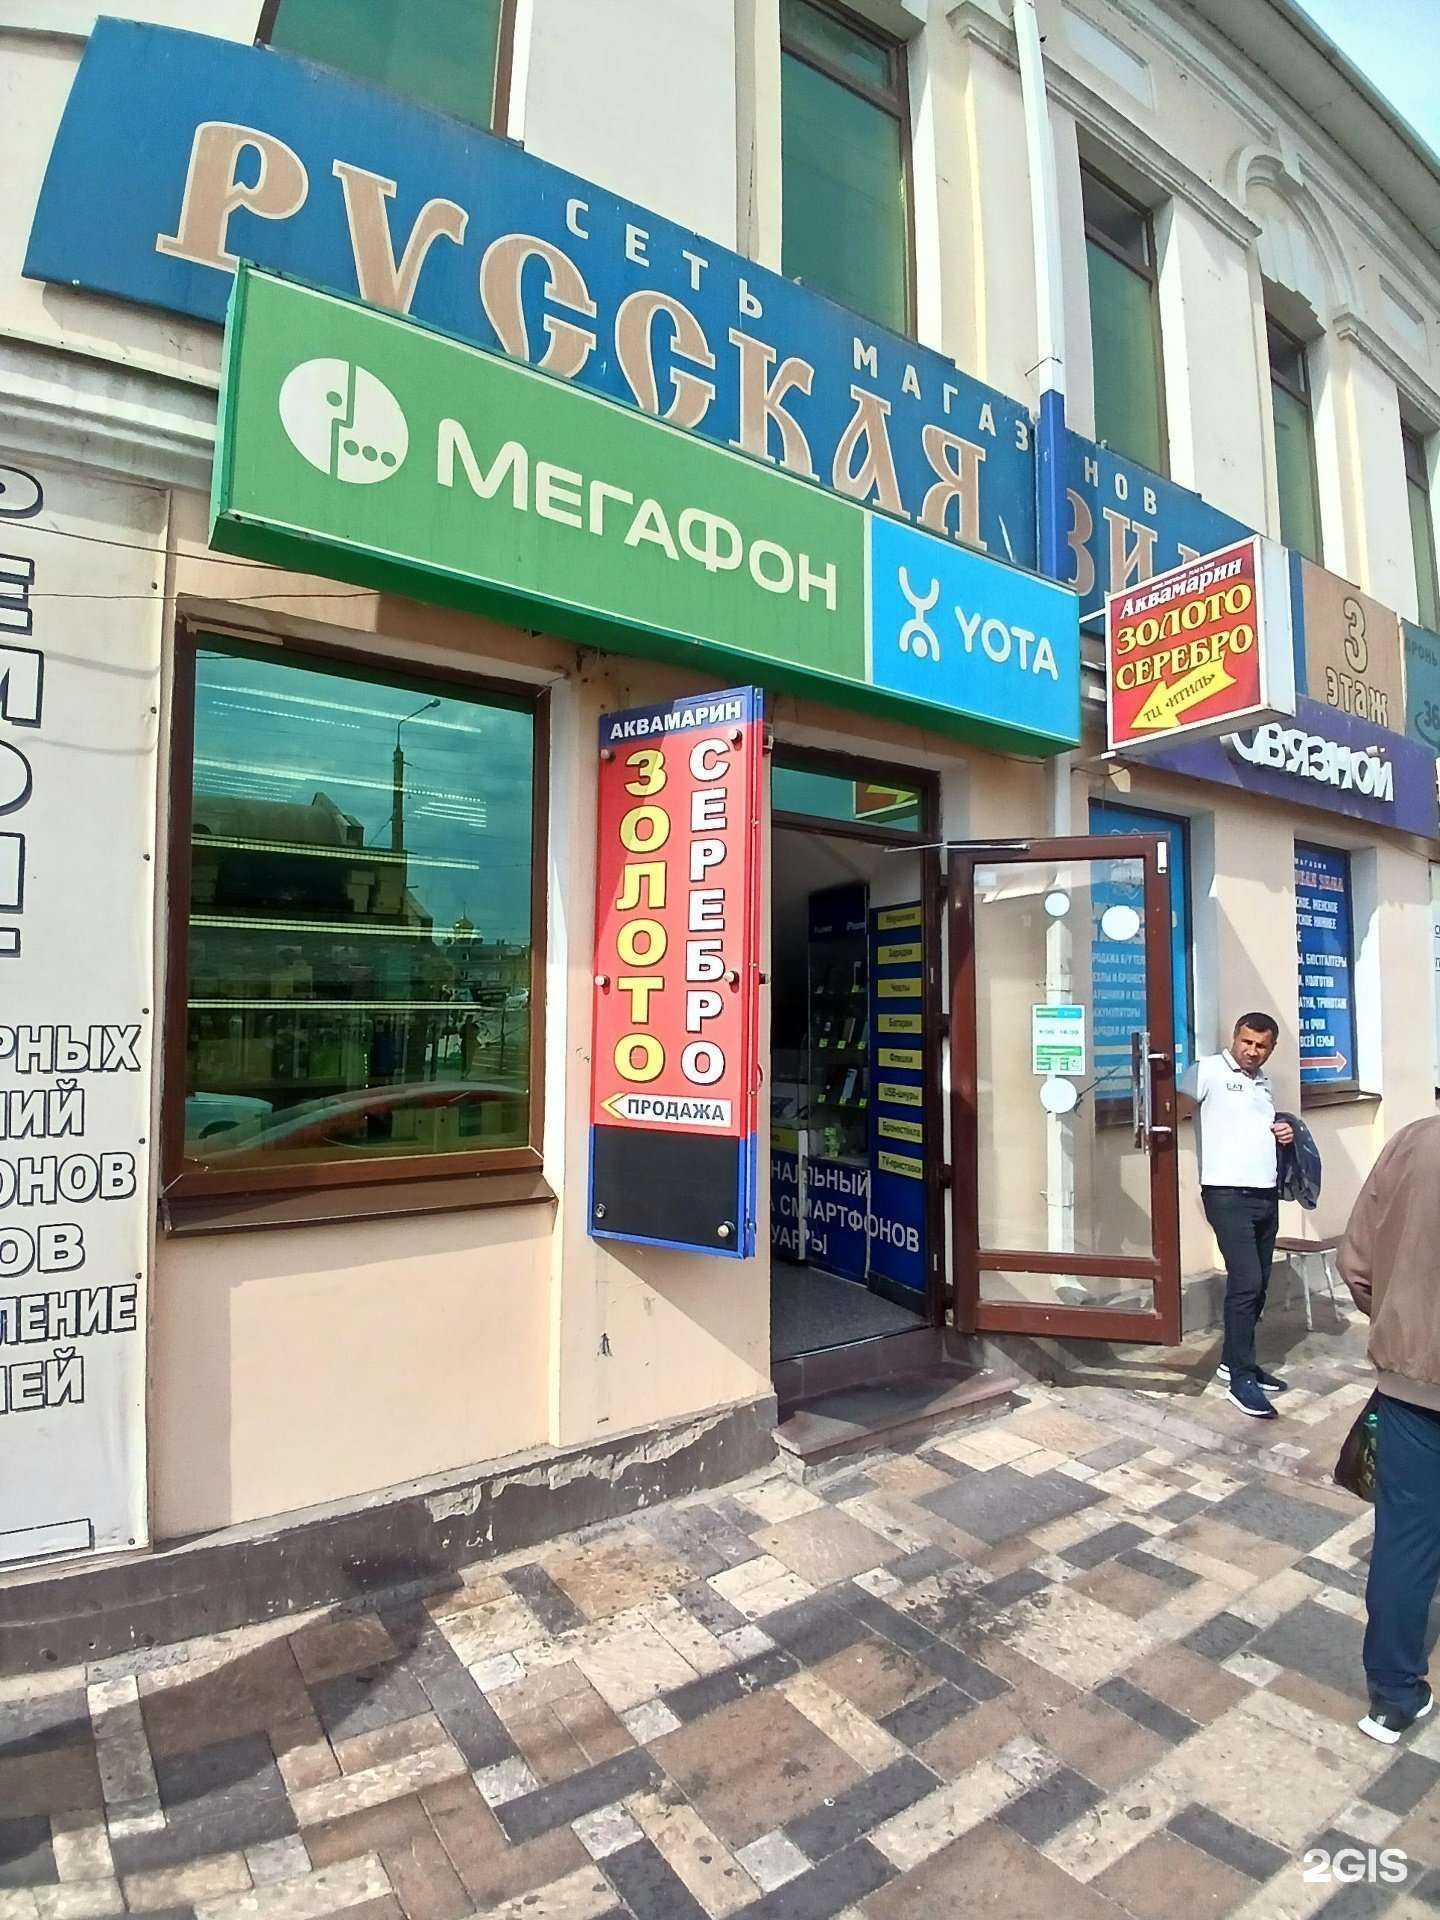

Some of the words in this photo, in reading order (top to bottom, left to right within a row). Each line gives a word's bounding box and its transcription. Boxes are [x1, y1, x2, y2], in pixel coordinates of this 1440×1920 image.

[155, 121, 988, 552] РУССКАЯ
[566, 199, 763, 319] СЕТЬ
[854, 337, 1157, 516] МАГАЗНОВ
[437, 418, 838, 611] МЕГАФОН
[1116, 583, 1252, 655] ЗОЛОТО
[1120, 558, 1242, 619] Аквамарин
[954, 605, 1060, 680] YOTA
[1115, 624, 1254, 691] СЕРЕБРО
[1343, 597, 1368, 674] 3
[610, 701, 742, 740] АКВАМАРИН
[1143, 705, 1163, 722] ТЦ
[613, 748, 671, 1084] ЗОЛОТО
[680, 738, 731, 1085] СЕРЕБРО
[0, 1079, 85, 1139] ИЙ
[627, 1098, 725, 1121] ПРОДАЖА
[780, 1195, 920, 1253] СМАРТФОНОВ
[0, 1347, 85, 1416] ЕЙ
